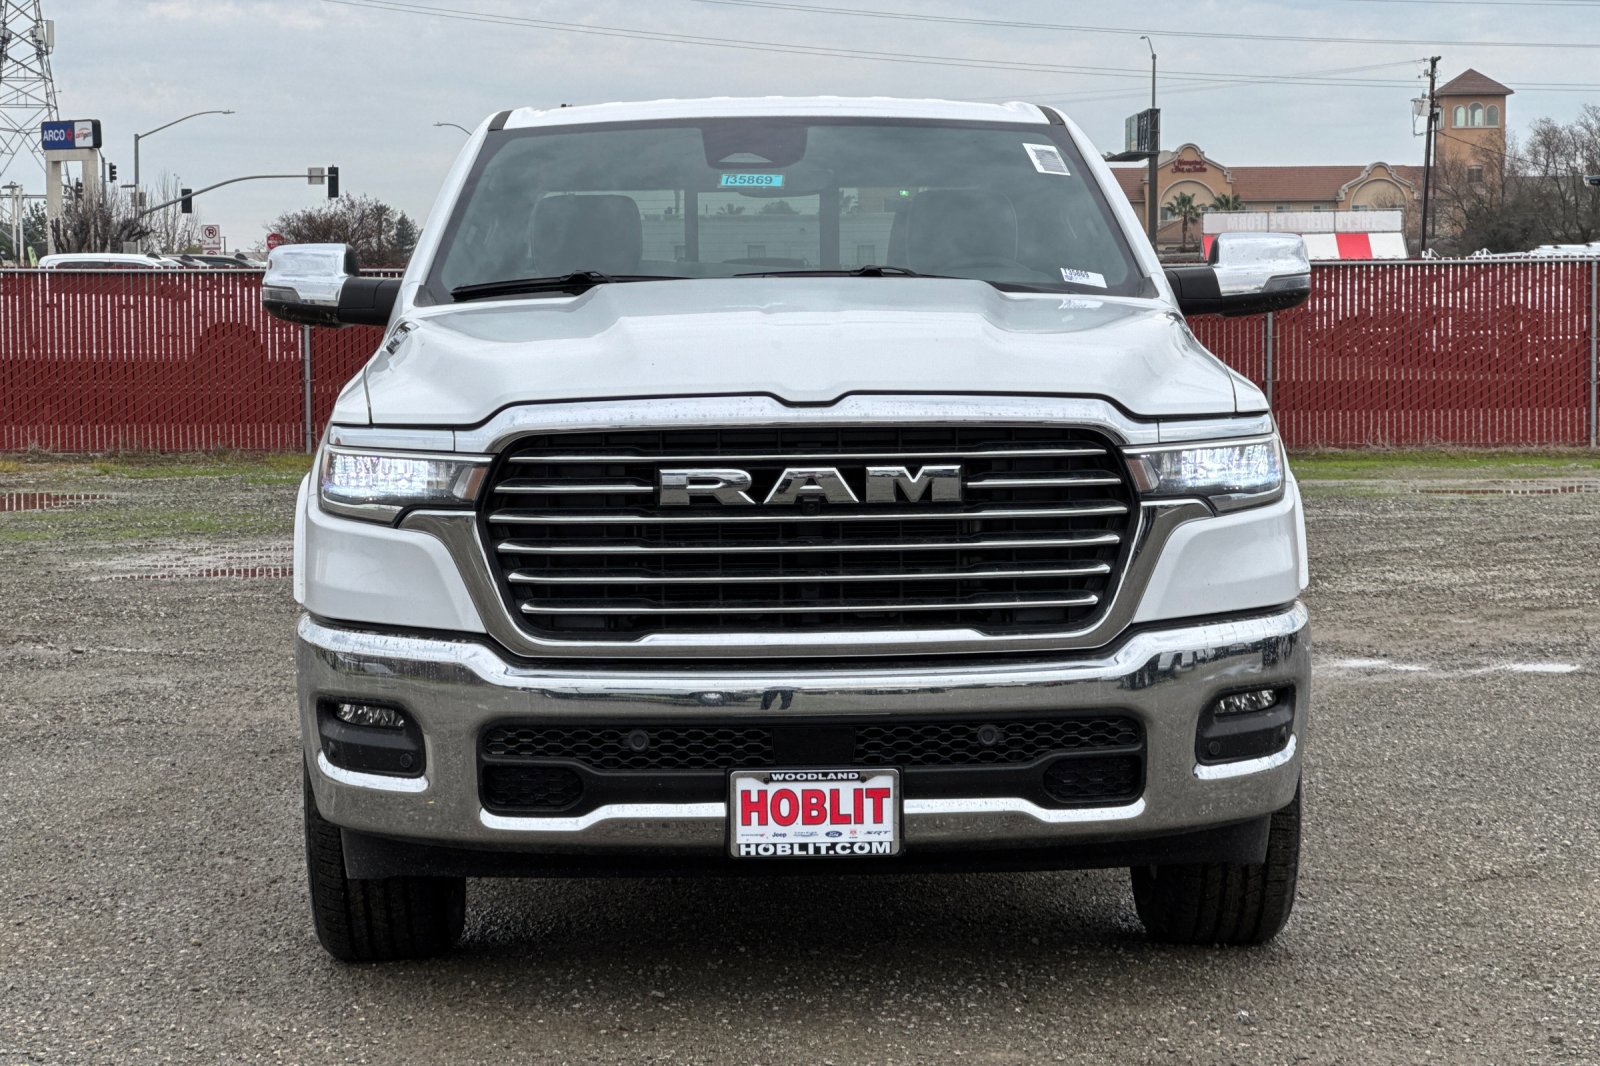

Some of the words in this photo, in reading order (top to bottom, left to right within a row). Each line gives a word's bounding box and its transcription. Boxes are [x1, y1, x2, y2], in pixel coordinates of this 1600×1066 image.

[43, 129, 66, 141] ARCO
[659, 465, 962, 506] RAM
[770, 772, 859, 781] WOODLAND
[740, 787, 891, 827] HOBLIT
[772, 831, 787, 839] Jeep
[739, 842, 891, 856] HOBLIT.COM
